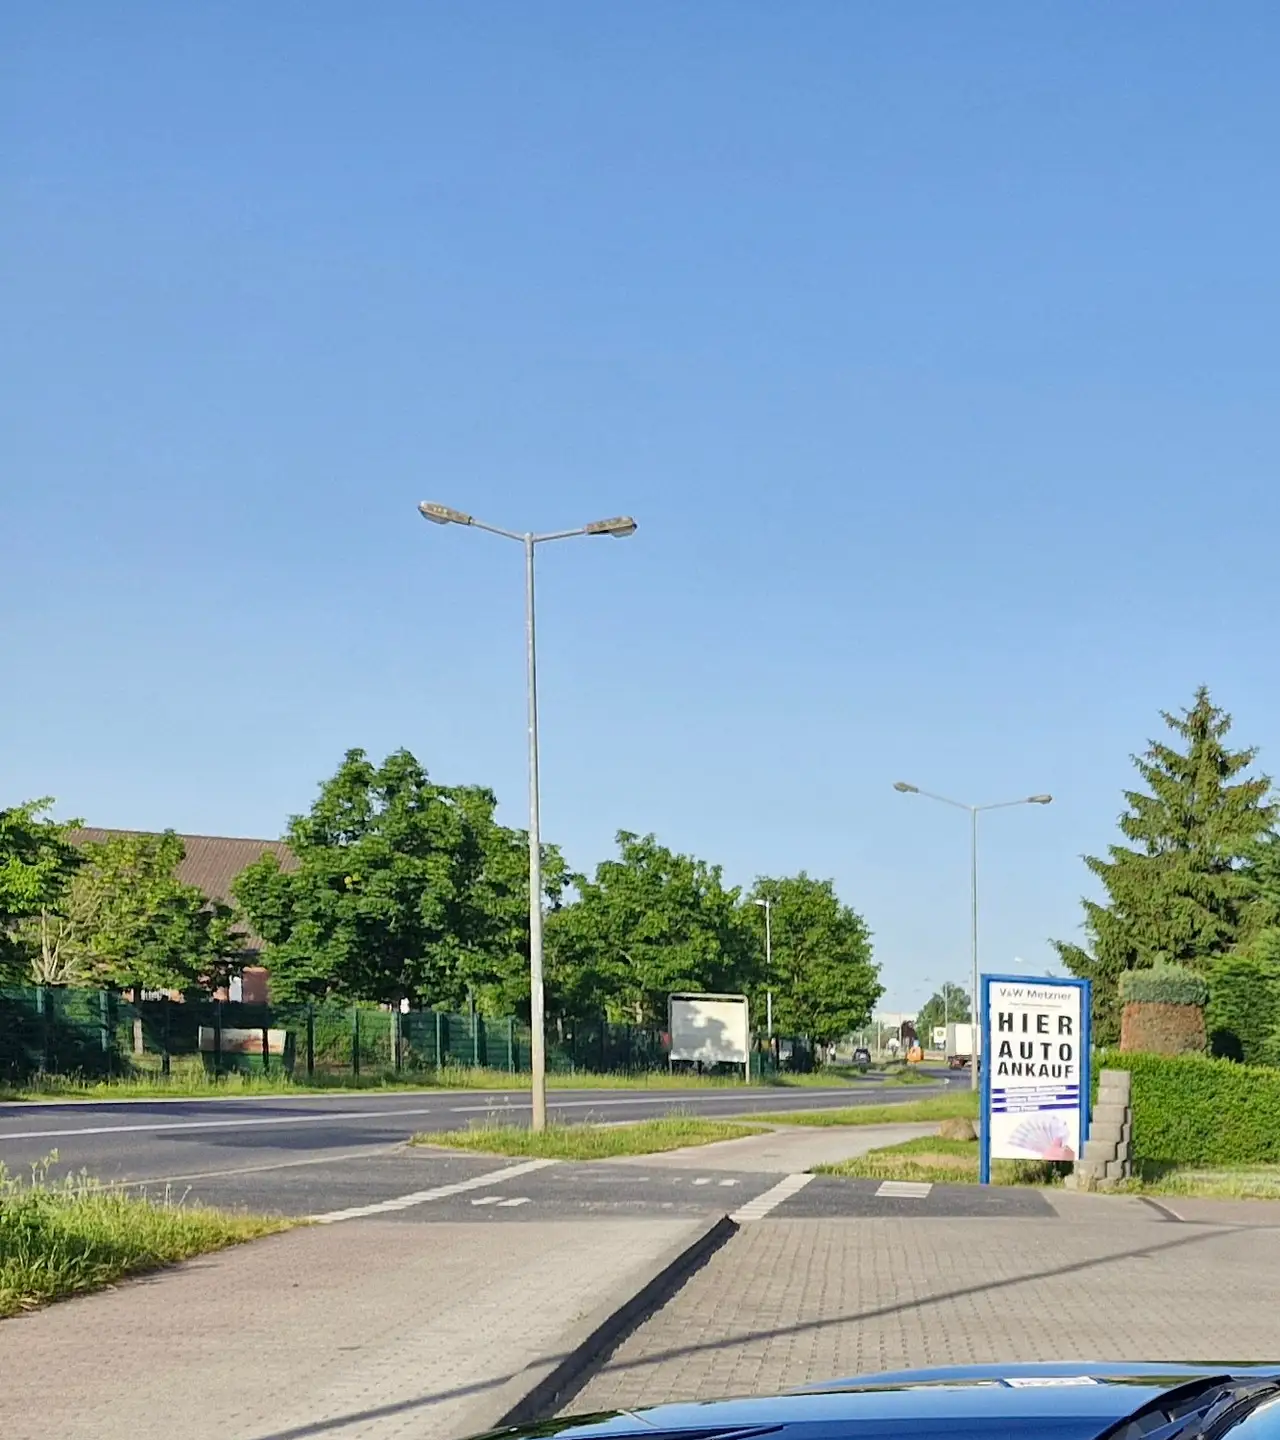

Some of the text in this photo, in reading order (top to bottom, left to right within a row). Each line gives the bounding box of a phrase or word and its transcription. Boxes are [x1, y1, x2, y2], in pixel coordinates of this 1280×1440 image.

[1027, 989, 1072, 1001] Metzner
[998, 1012, 1073, 1035] HIER
[998, 1040, 1073, 1062] AUTO
[997, 1061, 1074, 1078] ANKAUF
